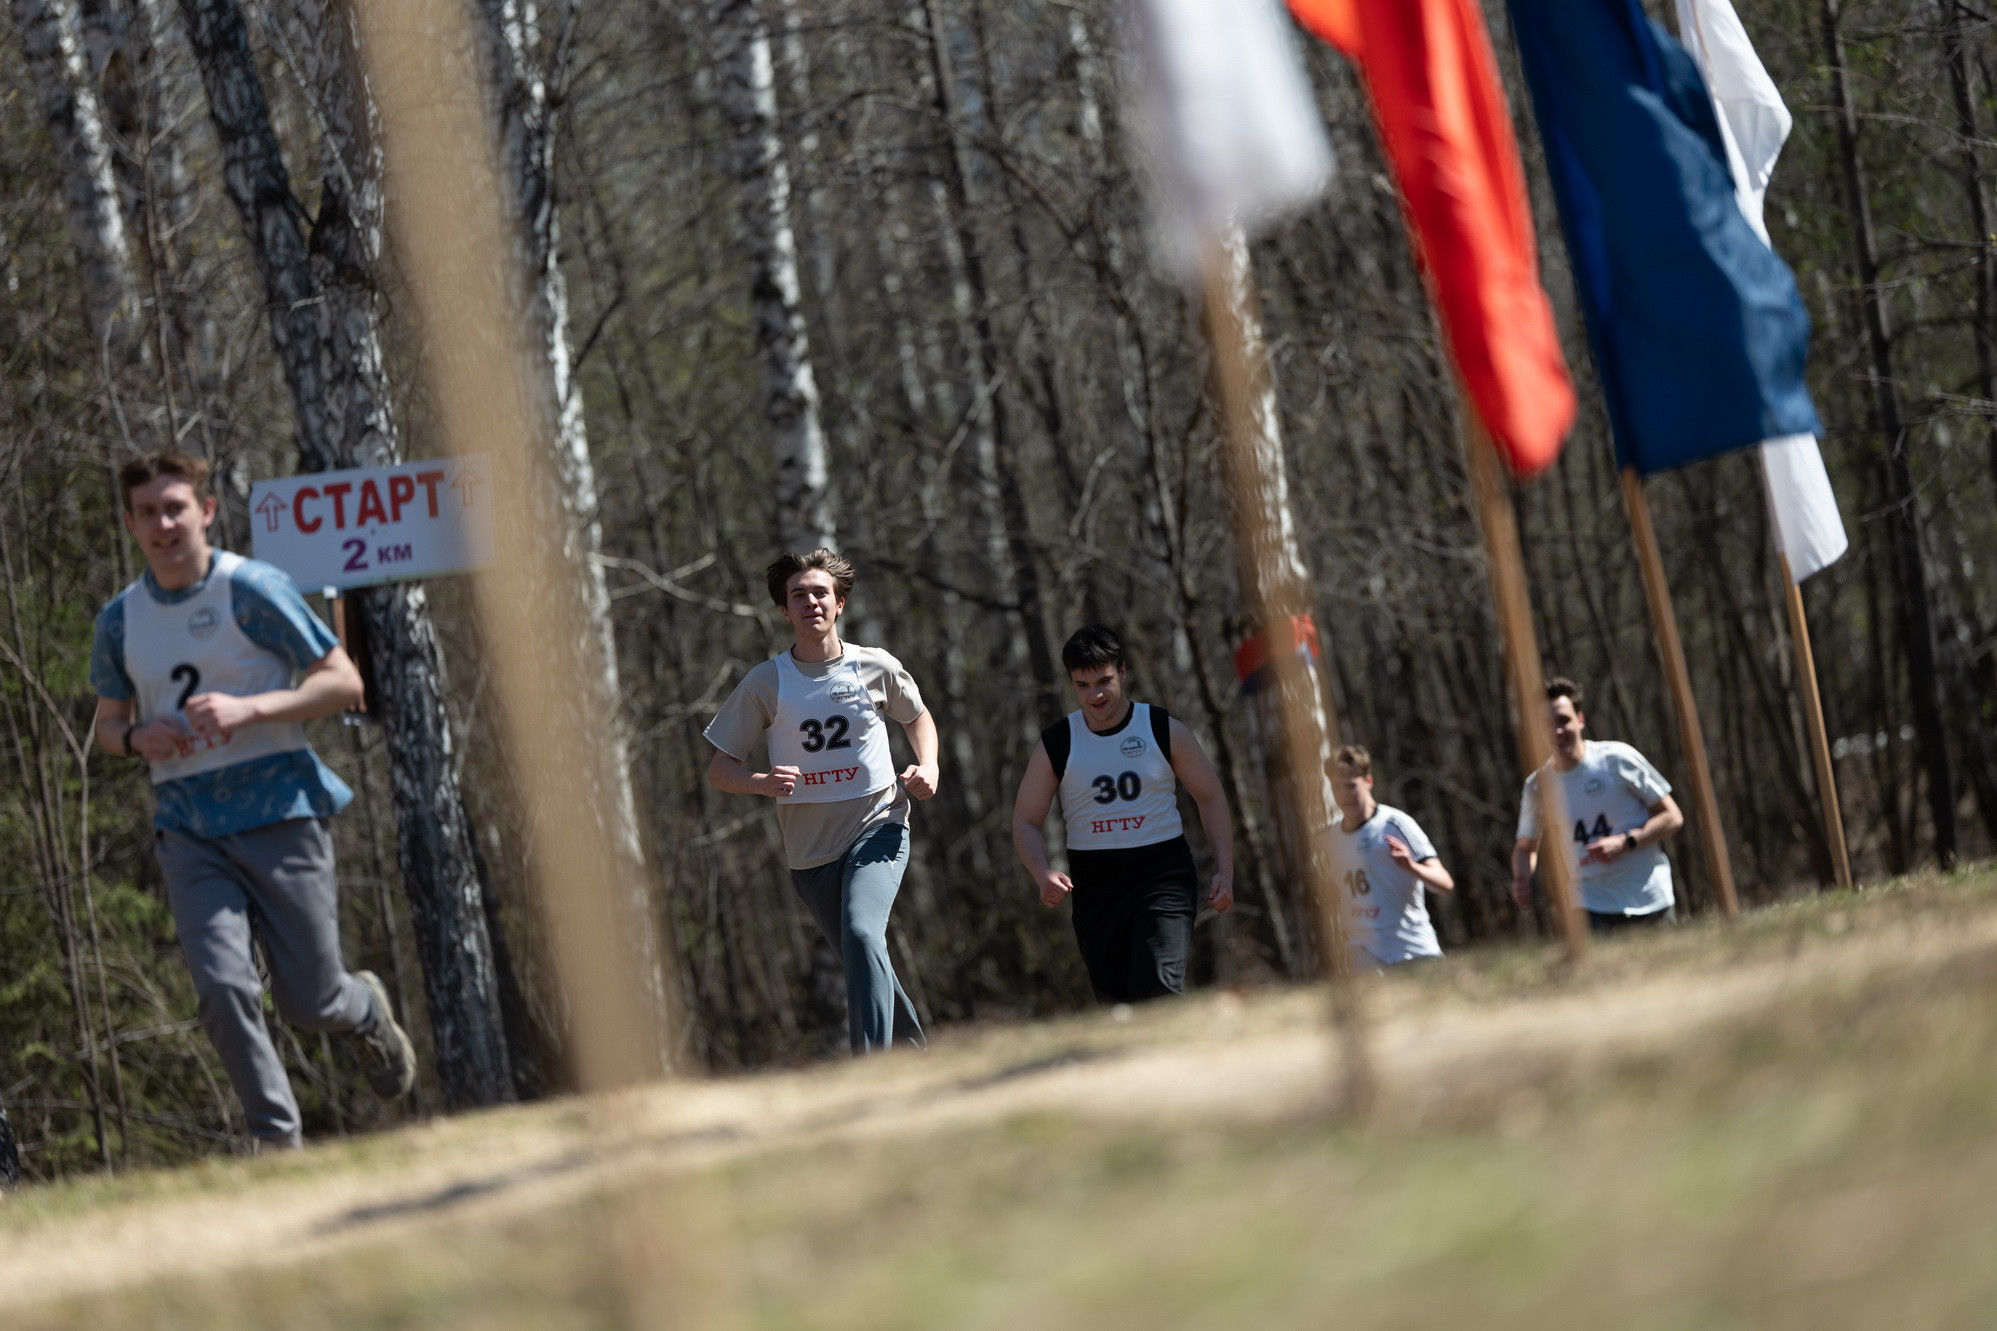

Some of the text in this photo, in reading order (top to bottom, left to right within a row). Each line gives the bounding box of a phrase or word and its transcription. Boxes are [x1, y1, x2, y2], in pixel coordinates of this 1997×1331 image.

[293, 470, 445, 534] СТАРТ
[342, 537, 369, 572] 2
[171, 664, 200, 711] 2
[799, 714, 852, 753] 32
[803, 766, 859, 786] НГТУ
[1091, 770, 1142, 805] 30
[1091, 816, 1146, 833] НГТУ
[1573, 812, 1613, 845] 44
